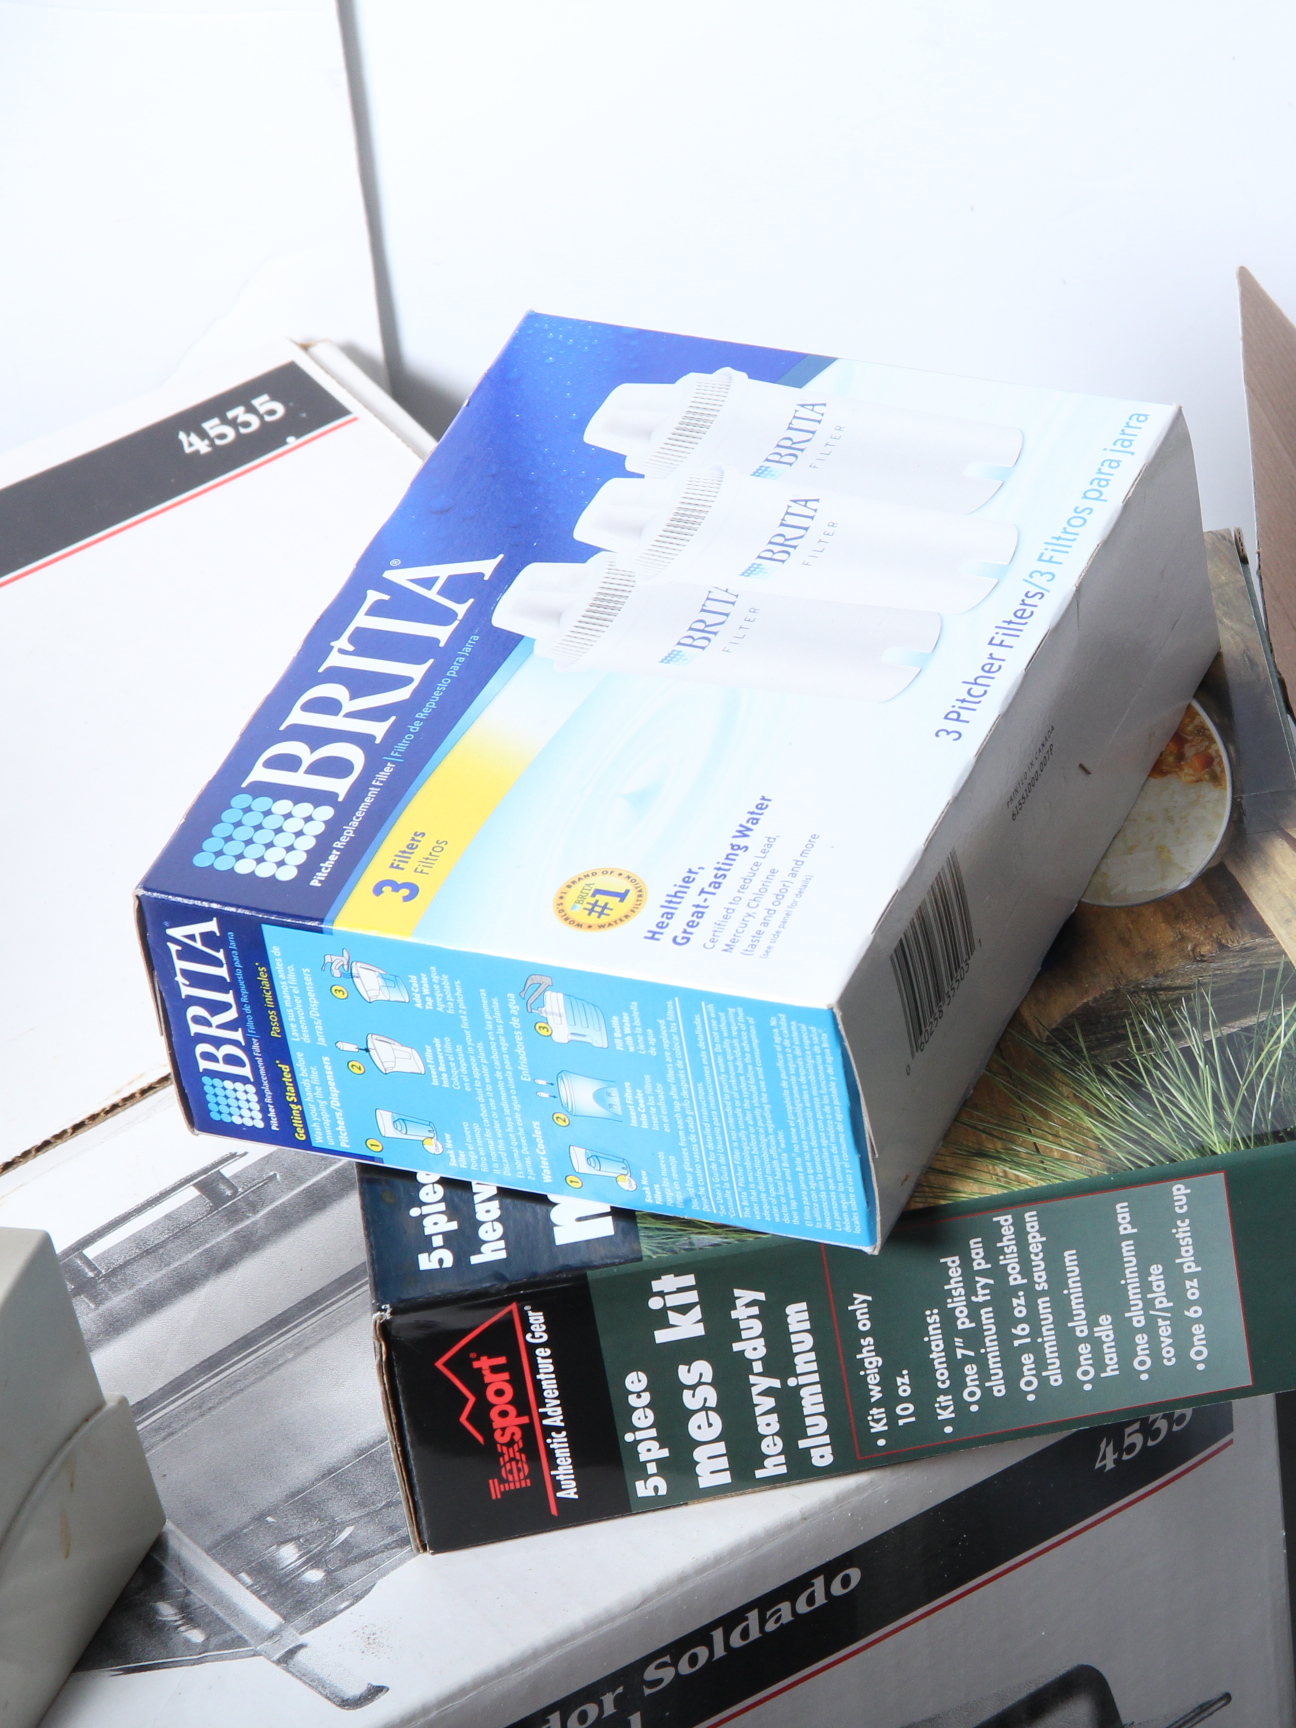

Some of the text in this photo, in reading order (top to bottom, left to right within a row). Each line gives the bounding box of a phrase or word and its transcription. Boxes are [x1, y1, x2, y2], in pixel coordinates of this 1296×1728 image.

[178, 393, 285, 455] 4535
[762, 403, 827, 467] BRITA
[1103, 411, 1150, 456] jarra
[1081, 458, 1122, 503] para
[756, 498, 820, 564] BRITA
[1037, 505, 1094, 565] Filtros
[241, 553, 505, 801] BRITA
[943, 652, 1006, 724] Pitcher
[309, 634, 480, 887] Pitcher Replacement Filter Filtro de Repuesto para Jarra
[935, 728, 962, 742] 3
[372, 879, 420, 902] 3
[389, 831, 426, 871] Filters
[413, 839, 448, 876] Filtros
[672, 795, 772, 946] Great-Tasting Water
[643, 866, 706, 942] Healthier,
[166, 916, 254, 1083] BRITA
[289, 1104, 306, 1141] Getting
[409, 1172, 458, 1270] 5-piec
[470, 1181, 507, 1265] heav
[940, 1255, 976, 1330] polished
[969, 1237, 1006, 1397] aluminum fry pan
[993, 1214, 1038, 1391] One 16 oz. polished
[1024, 1210, 1063, 1387] aluminum saucepan
[1063, 1249, 1095, 1381] One aluminum
[1115, 1201, 1152, 1371] One aluminum pan
[1147, 1263, 1176, 1366] cover/plate
[1171, 1183, 1208, 1361] One 6 oz plastic cup
[648, 1273, 732, 1488] mess kit
[730, 1288, 788, 1479] heavy-duty
[785, 1302, 834, 1467] aluminum
[848, 1293, 888, 1433] Kit weighs only
[923, 1308, 955, 1420] Kit contains:
[962, 1363, 981, 1402] One
[1094, 1314, 1120, 1378] handle
[525, 1310, 579, 1499] Authentic Adventure Gear
[624, 1371, 669, 1498] 5-piece
[895, 1369, 916, 1426] 10 oz.
[643, 1566, 862, 1696] Soldado
